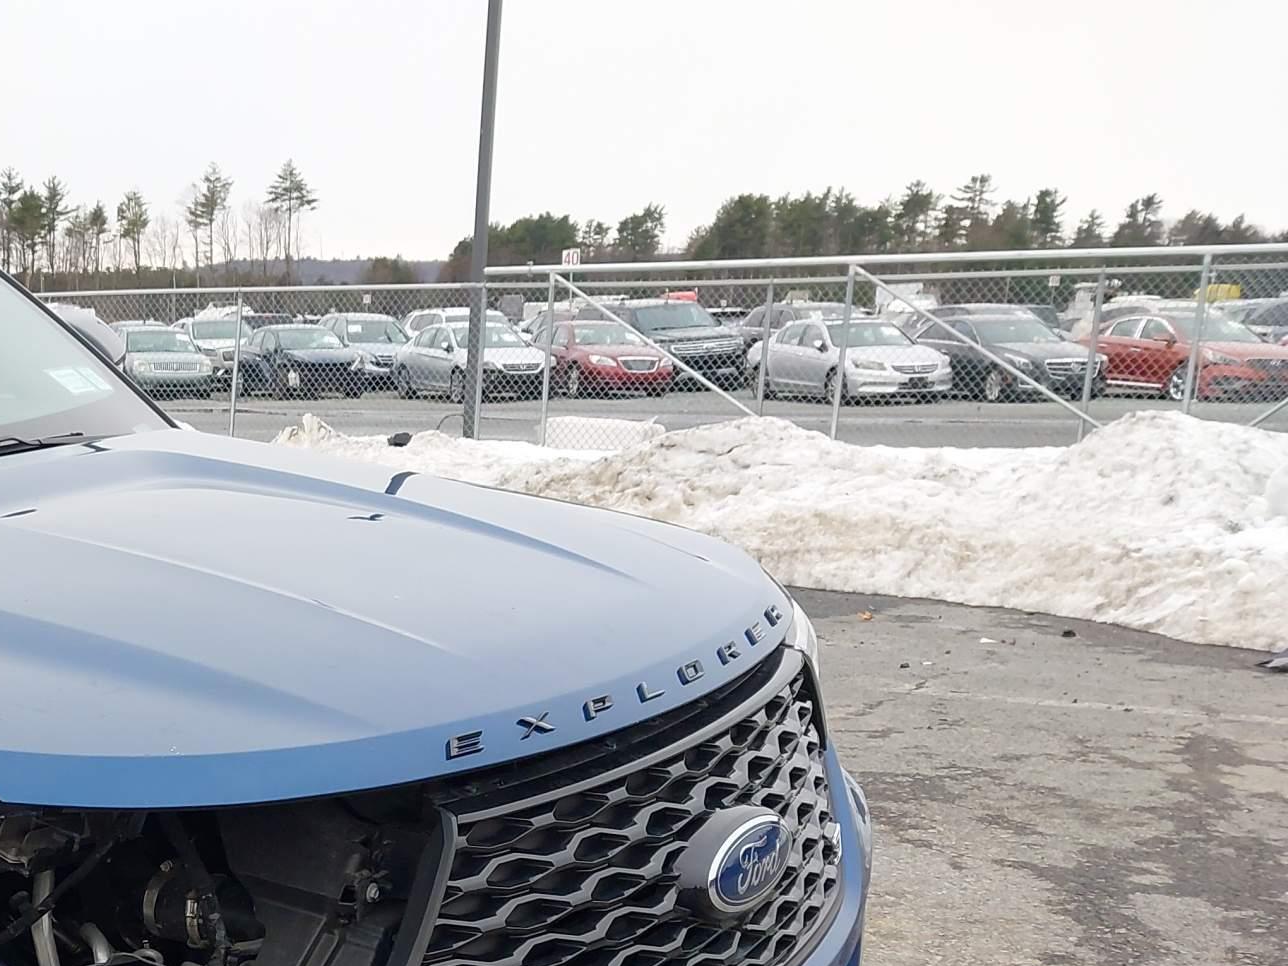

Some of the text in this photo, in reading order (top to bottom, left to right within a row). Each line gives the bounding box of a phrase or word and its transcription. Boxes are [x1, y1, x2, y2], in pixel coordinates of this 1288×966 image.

[563, 250, 579, 265] 40
[446, 603, 784, 760] EXPLORER
[737, 835, 781, 895] Ford
